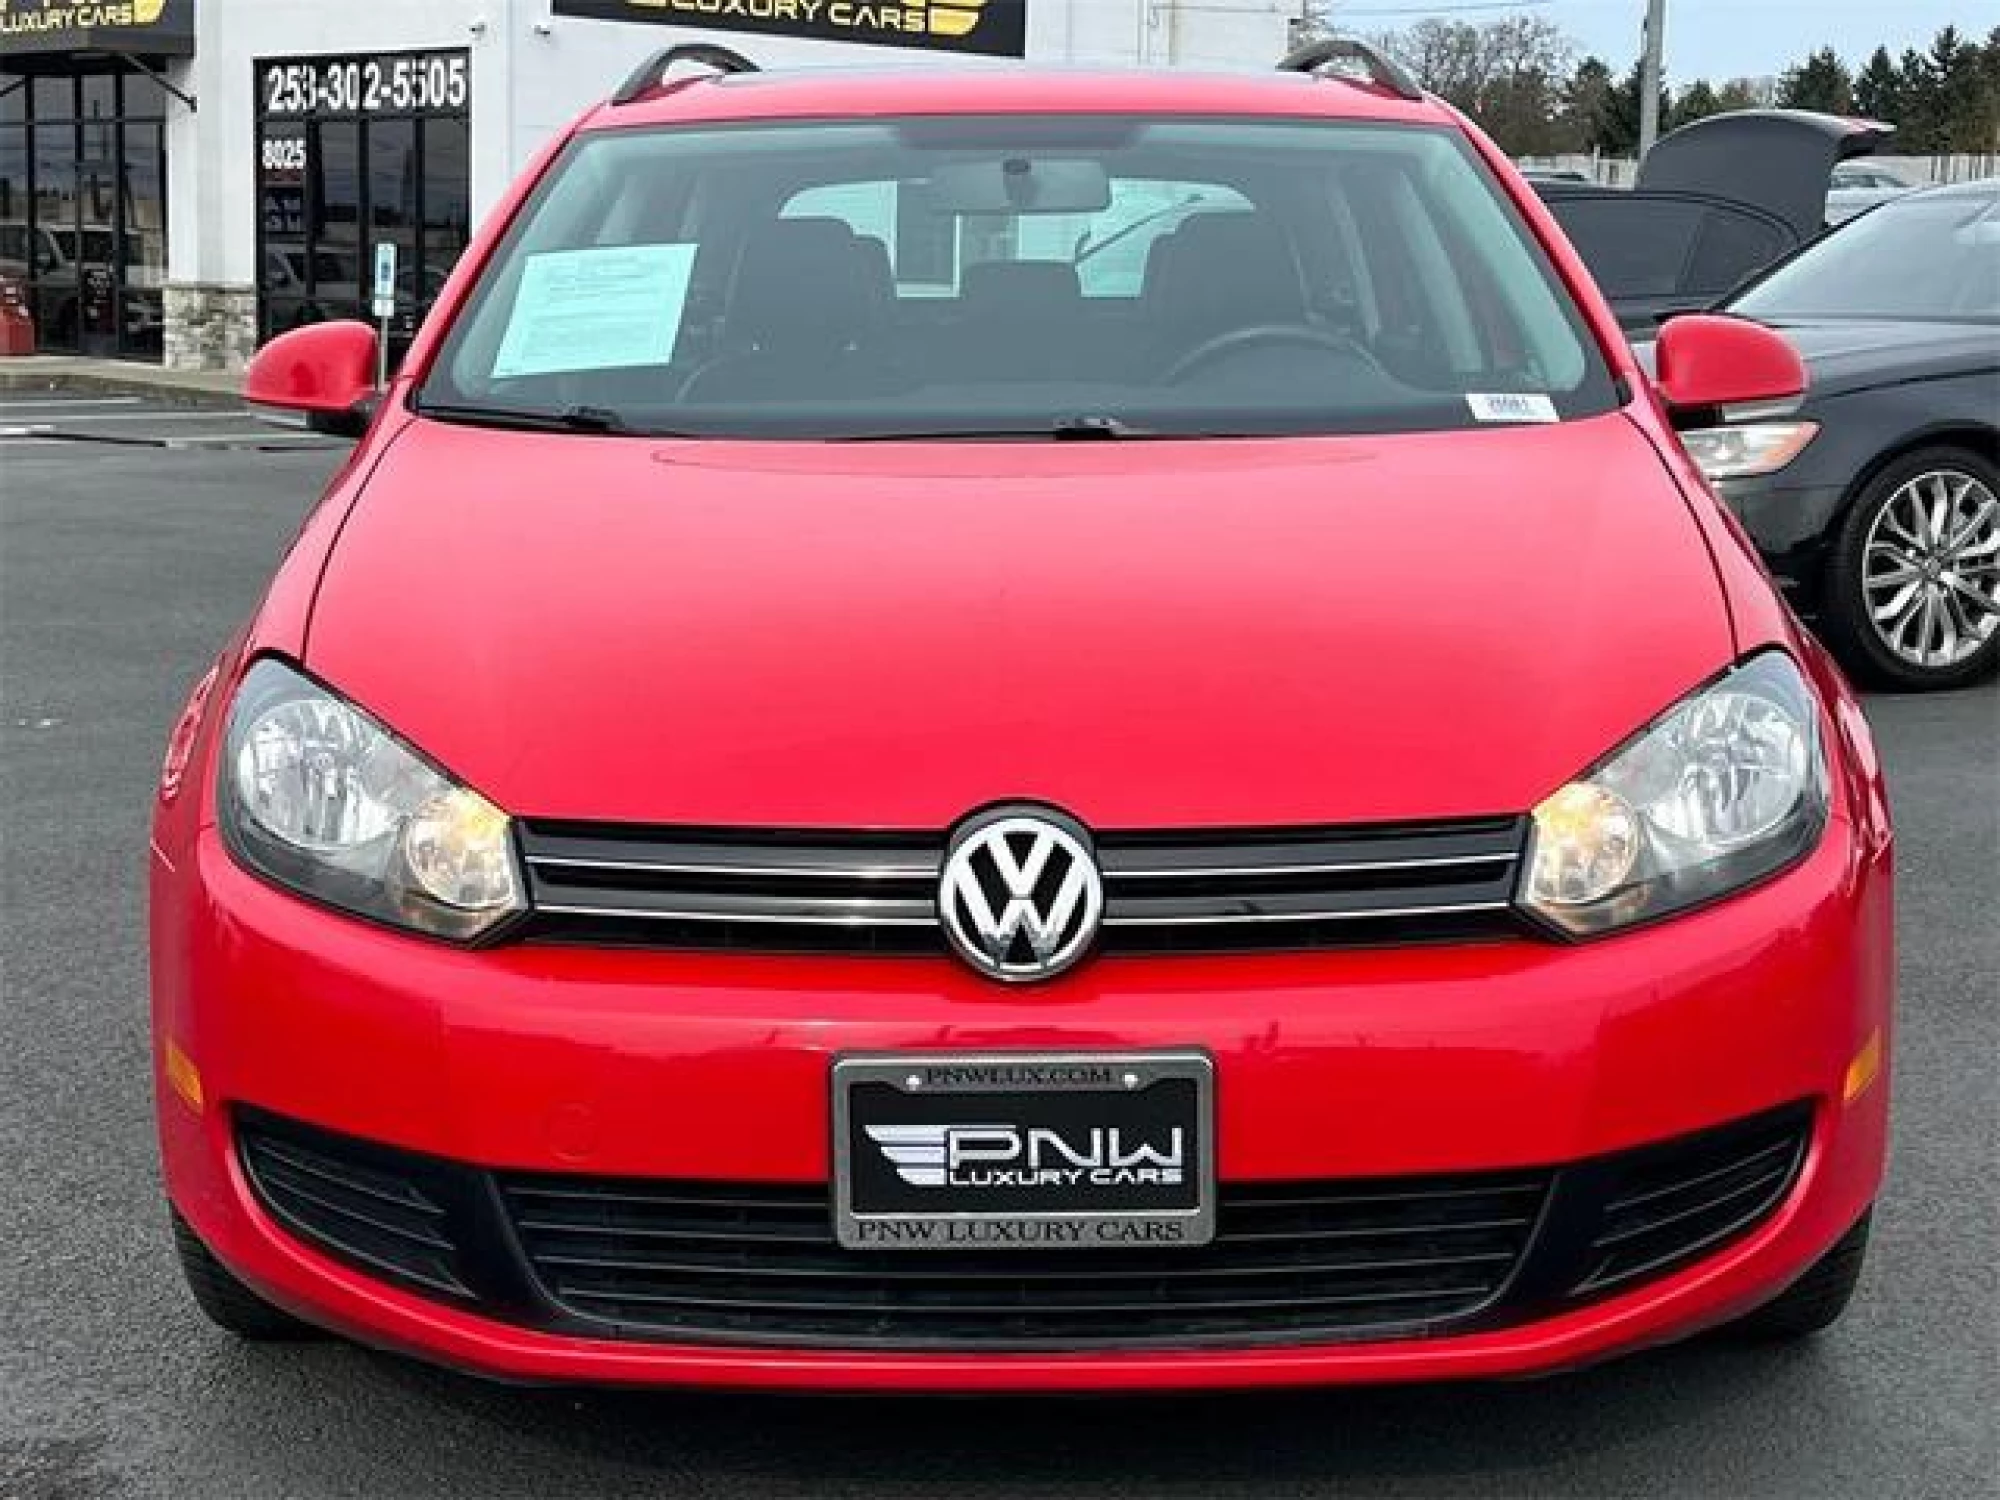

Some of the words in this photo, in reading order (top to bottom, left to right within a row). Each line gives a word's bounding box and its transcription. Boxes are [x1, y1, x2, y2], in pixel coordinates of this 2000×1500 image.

[77, 3, 132, 26] CARS
[829, 5, 926, 33] CARS
[262, 139, 306, 169] 8025
[949, 1125, 1182, 1169] PNW
[950, 1168, 1081, 1186] LUXURY
[1089, 1168, 1183, 1184] CARS
[858, 1221, 935, 1242] PNW
[948, 1221, 1088, 1242] LUXURY
[1097, 1220, 1184, 1241] CARS
